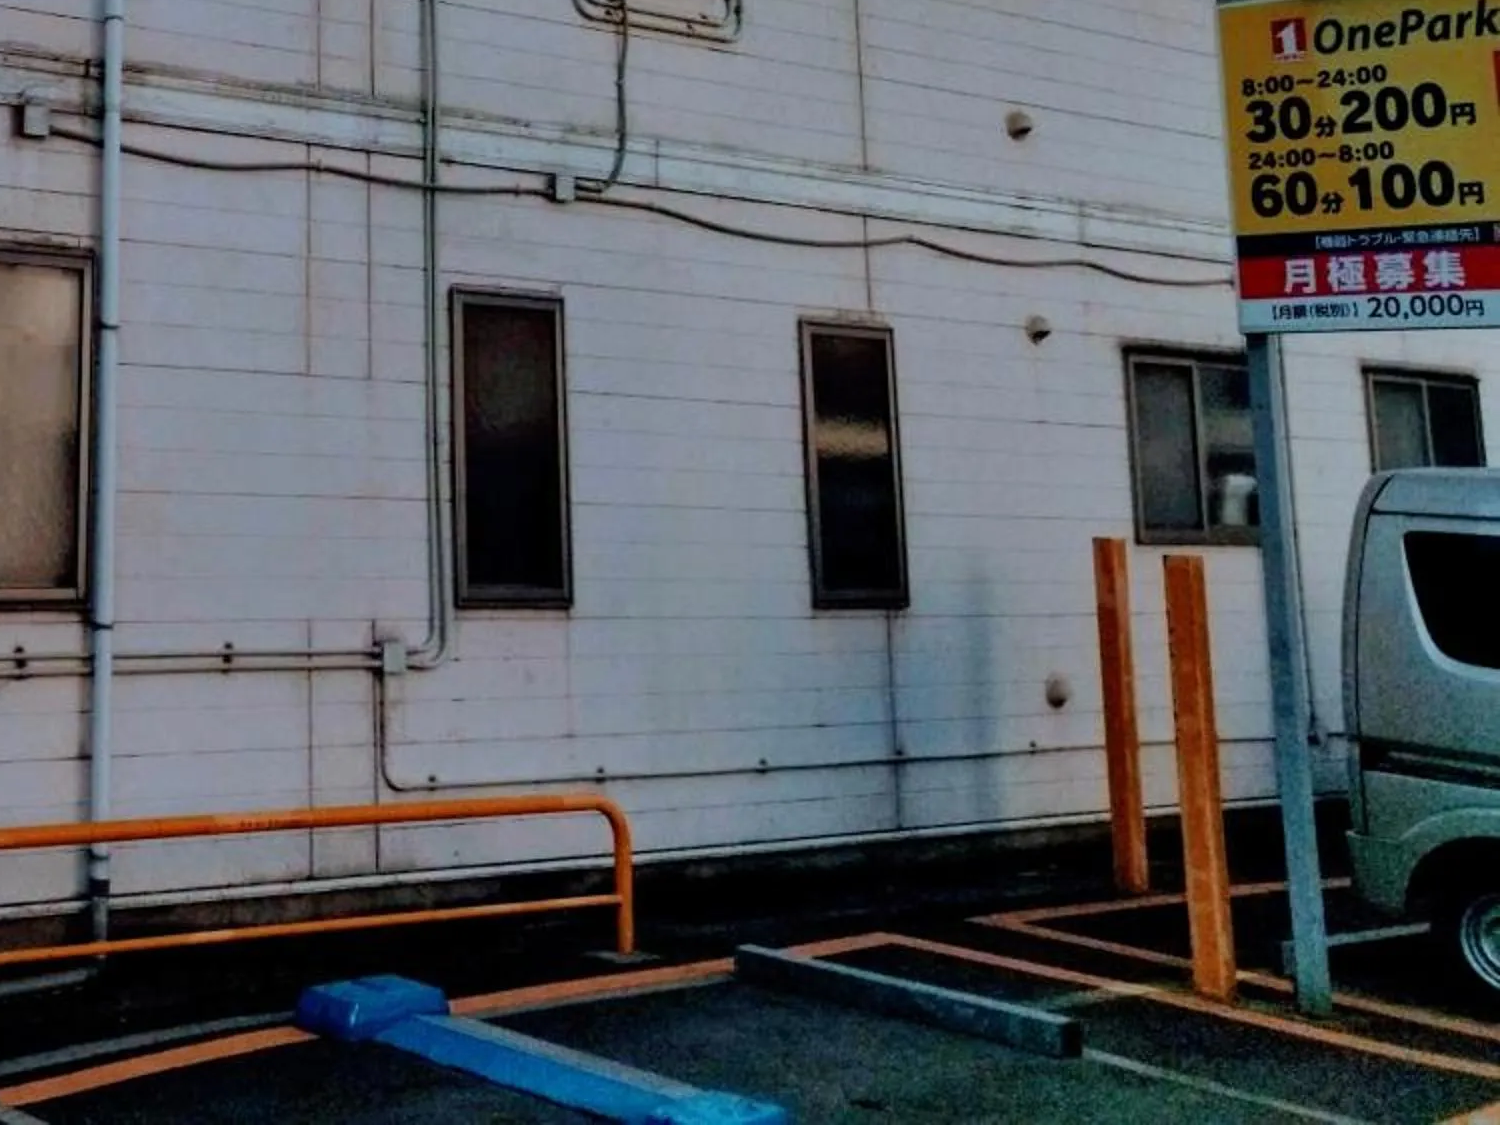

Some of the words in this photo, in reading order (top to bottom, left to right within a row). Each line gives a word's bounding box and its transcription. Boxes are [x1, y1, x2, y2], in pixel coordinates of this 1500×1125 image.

[1284, 250, 1466, 294] 月極募集
[1367, 294, 1485, 320] 20,000円
